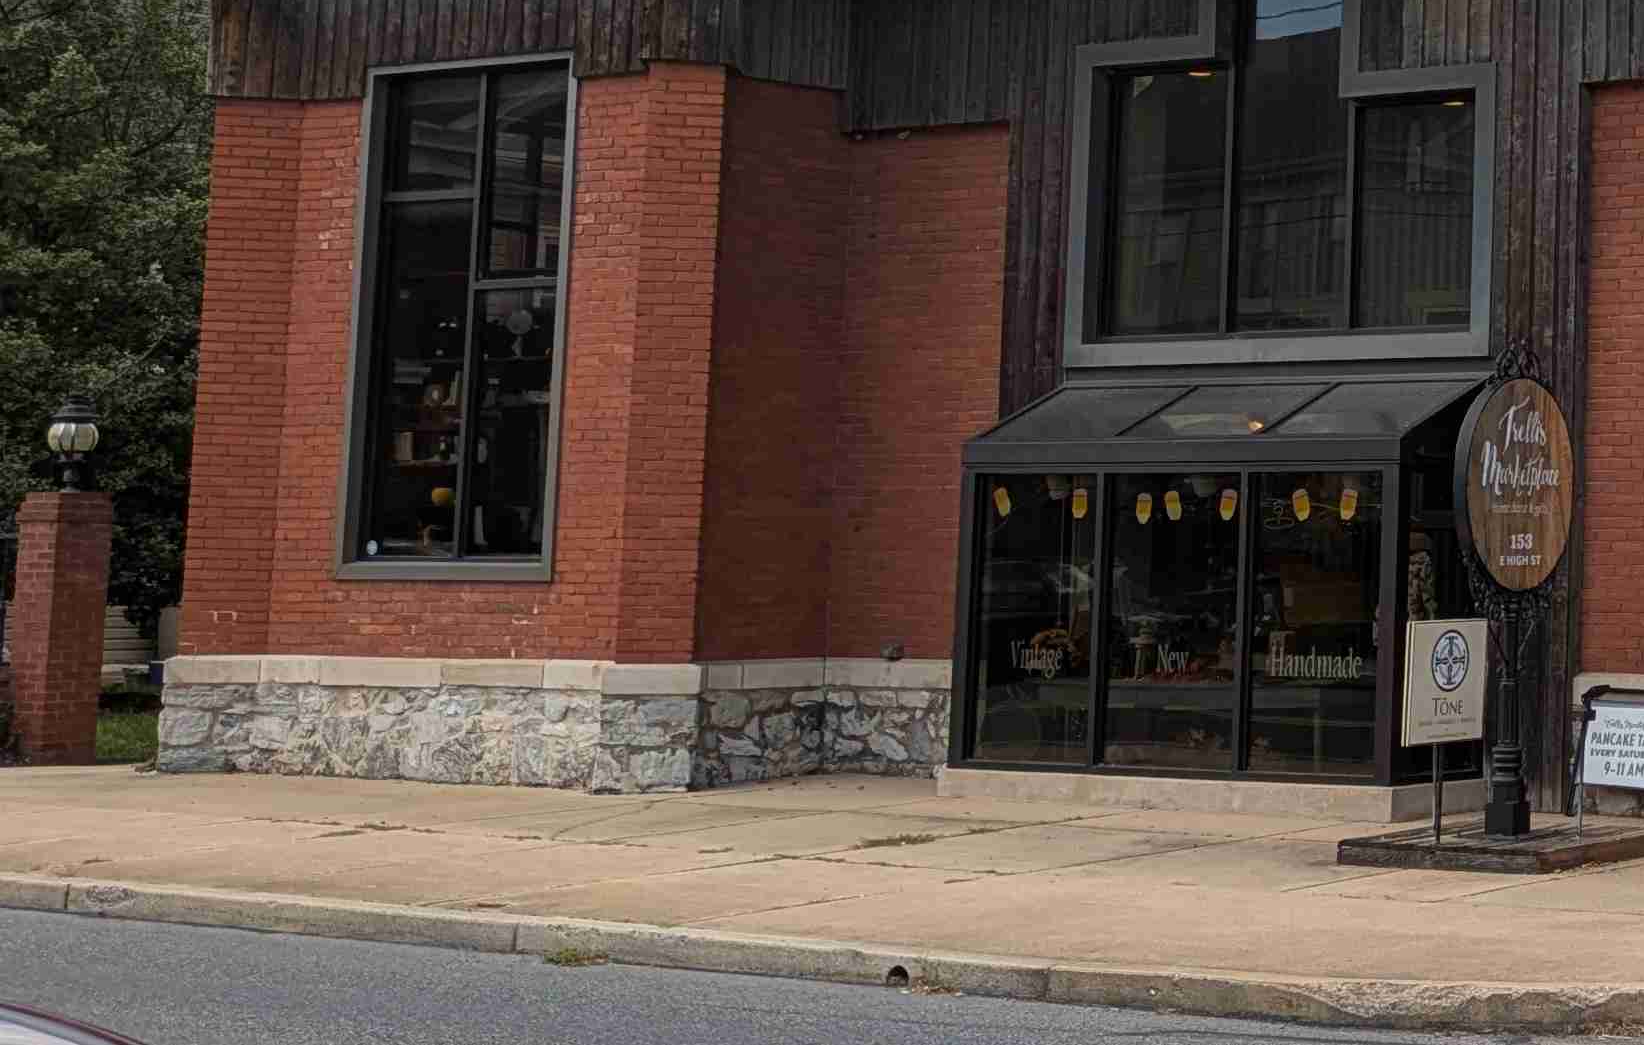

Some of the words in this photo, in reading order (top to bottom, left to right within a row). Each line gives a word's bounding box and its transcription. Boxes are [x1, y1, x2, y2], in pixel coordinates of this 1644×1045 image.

[1498, 396, 1547, 452] Trellis
[1480, 440, 1561, 496] Marketplace
[1511, 532, 1534, 550] 153
[1500, 555, 1506, 566] E
[1507, 555, 1529, 566] HIGH
[1530, 555, 1541, 565] ST
[1010, 639, 1064, 679] Vintage
[1157, 643, 1190, 673] New
[1270, 644, 1362, 678] Handmade
[1591, 732, 1636, 747] PANCAKE
[1591, 748, 1616, 757] EVERY
[1604, 761, 1625, 776] 9-11
